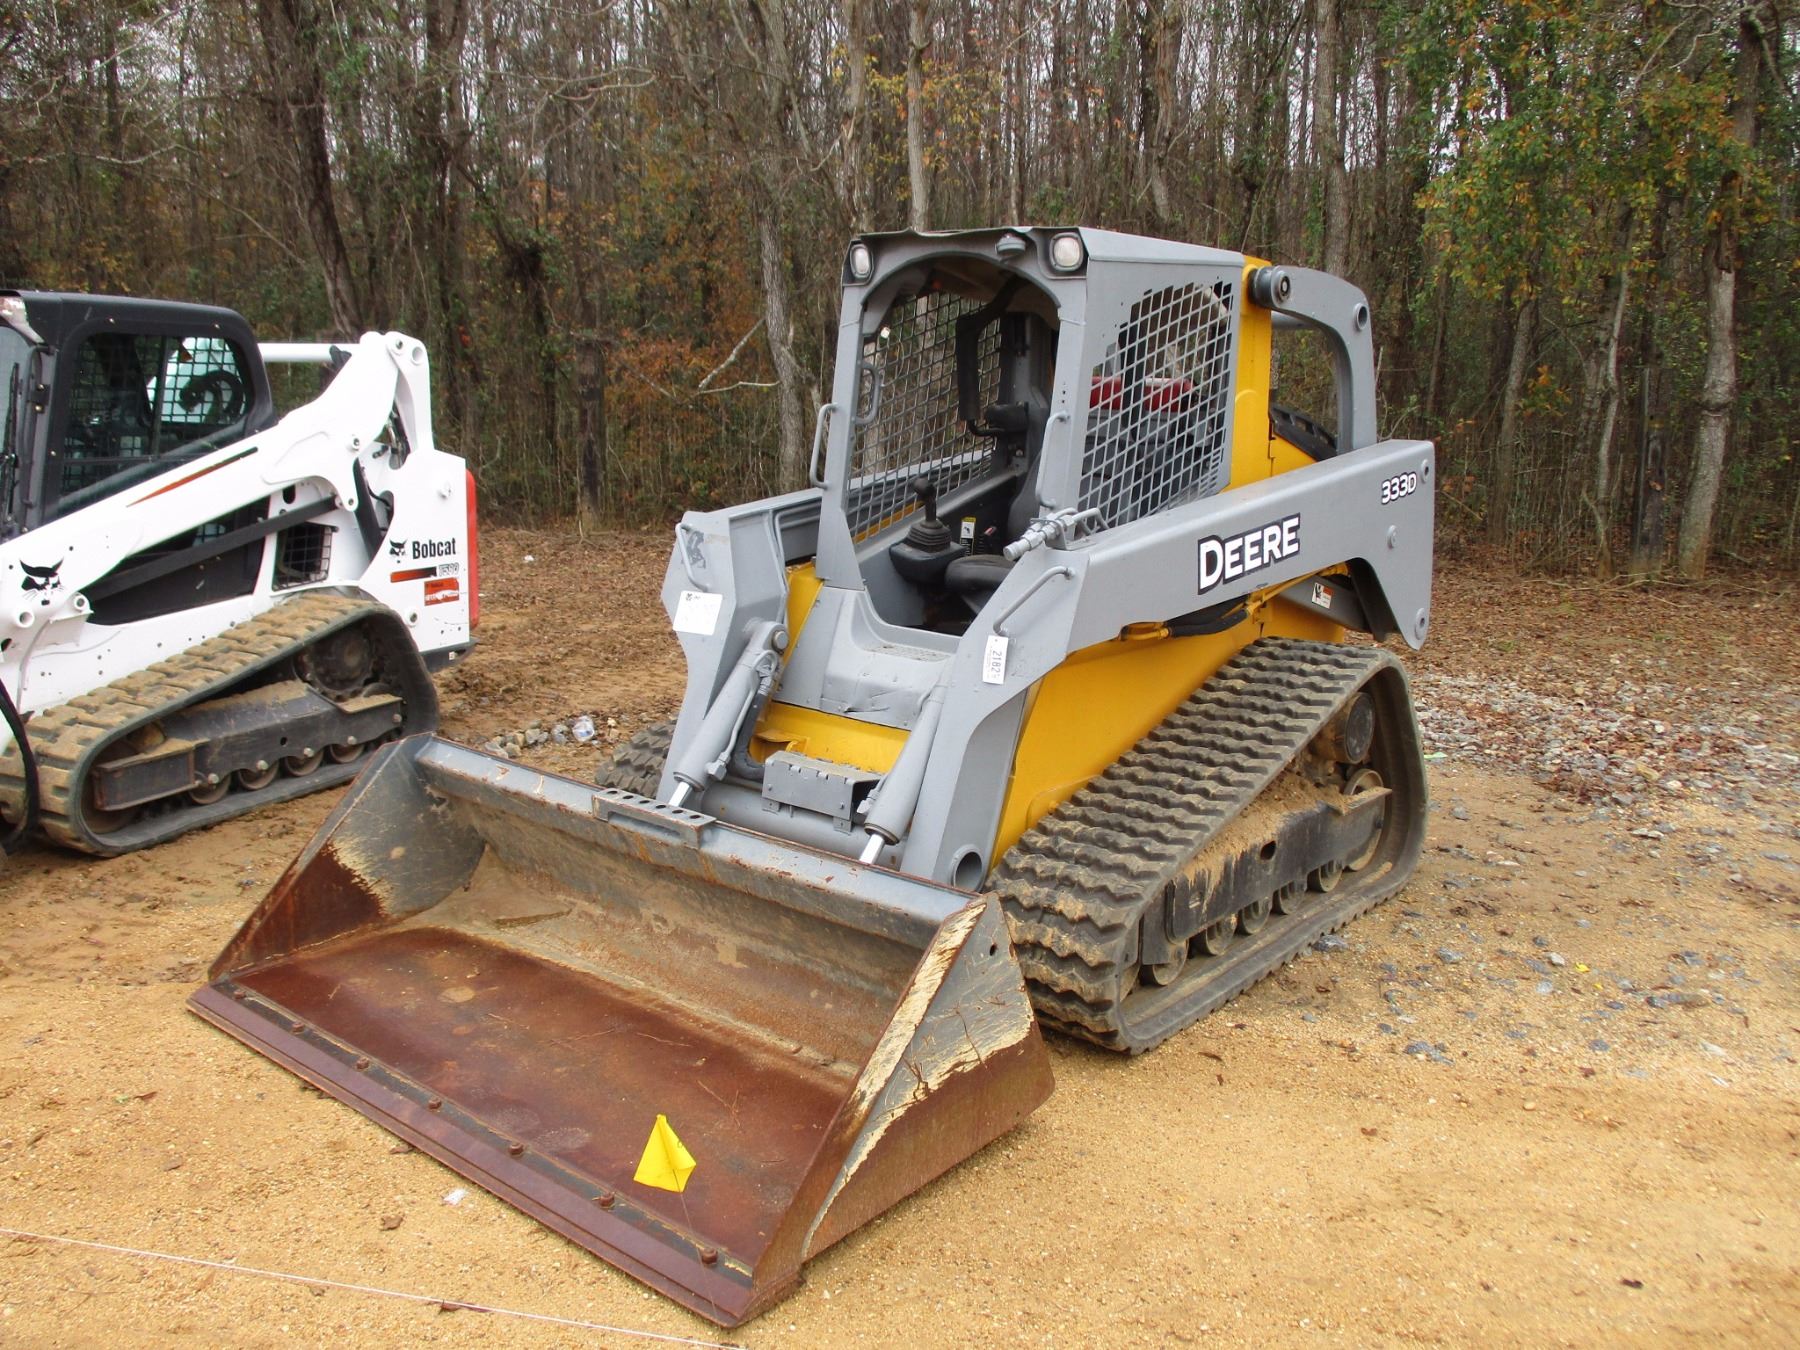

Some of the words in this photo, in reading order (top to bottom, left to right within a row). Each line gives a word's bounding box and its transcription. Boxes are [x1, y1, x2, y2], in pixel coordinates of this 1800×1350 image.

[1381, 472, 1417, 504] 333D
[412, 537, 456, 560] Bobcat
[1198, 512, 1301, 595] DEERE
[991, 650, 1003, 673] 2182
